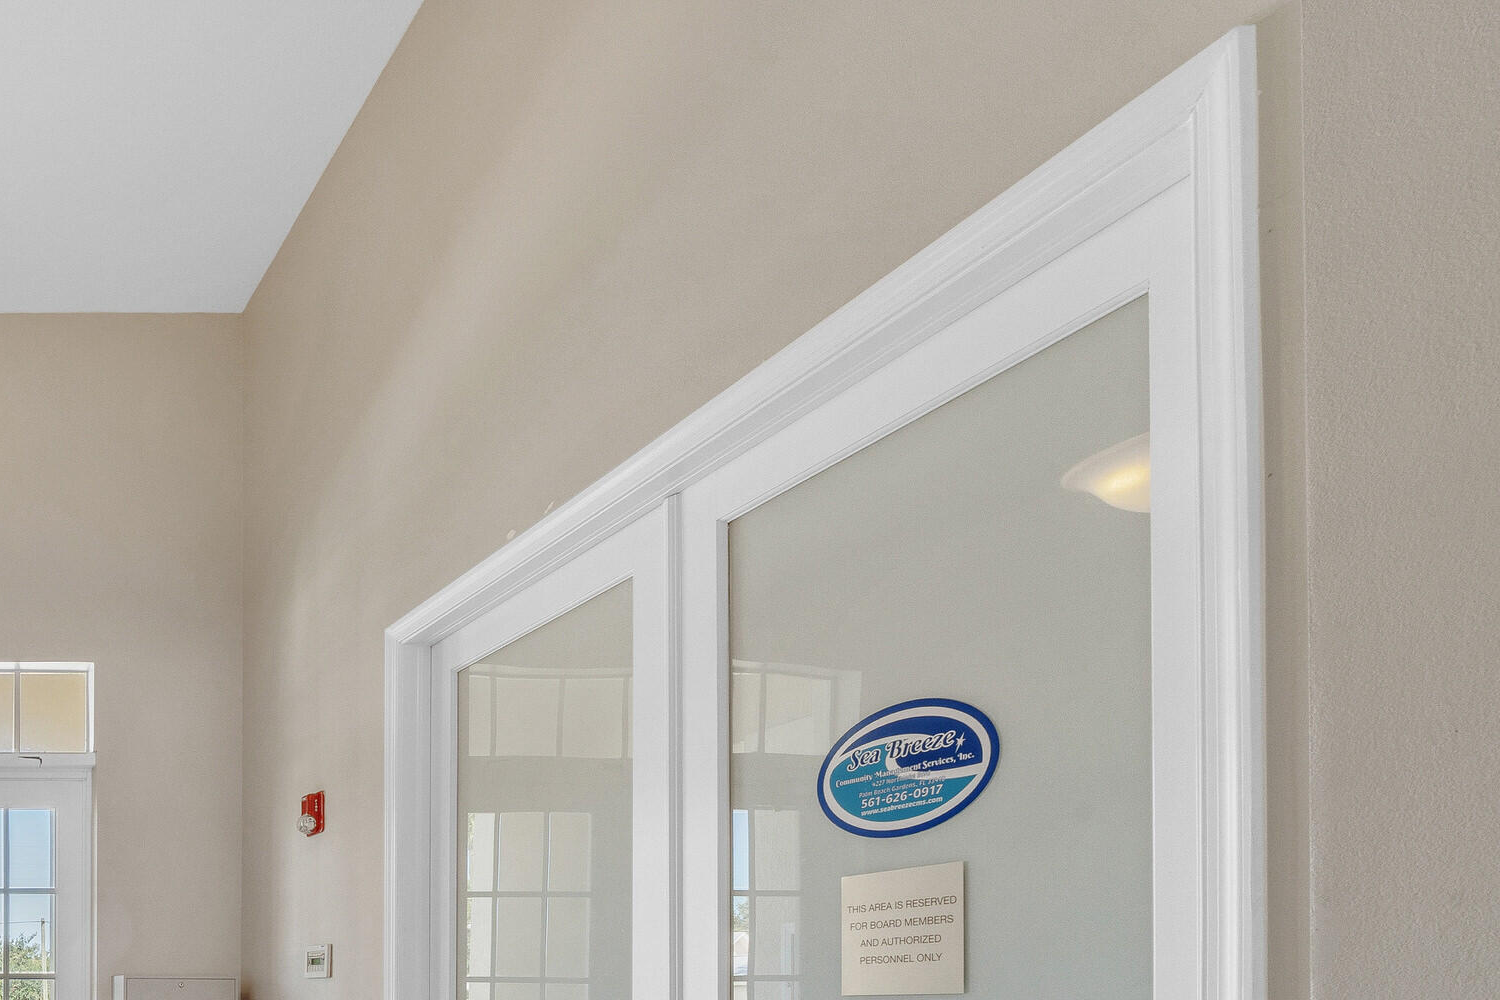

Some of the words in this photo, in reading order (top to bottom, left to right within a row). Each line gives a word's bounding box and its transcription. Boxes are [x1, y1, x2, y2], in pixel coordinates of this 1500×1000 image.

[847, 749, 881, 772] Sea
[885, 730, 956, 759] Breeze
[835, 774, 873, 788] Community
[922, 755, 957, 769] Services,
[859, 791, 873, 799] Palm
[873, 787, 891, 796] Beach
[861, 784, 943, 809] 561-626-0917
[847, 904, 867, 914] THIS
[868, 902, 893, 912] AREA
[894, 901, 903, 910] IS
[905, 895, 957, 909] RESERVED
[850, 922, 867, 931] FOR
[870, 918, 902, 930] BOARD
[904, 914, 954, 927] MEMBERS
[860, 938, 879, 948] AND
[881, 934, 942, 946] AUTHORIZED
[859, 954, 914, 965] PERSONNEL
[916, 952, 943, 963] ONLY
